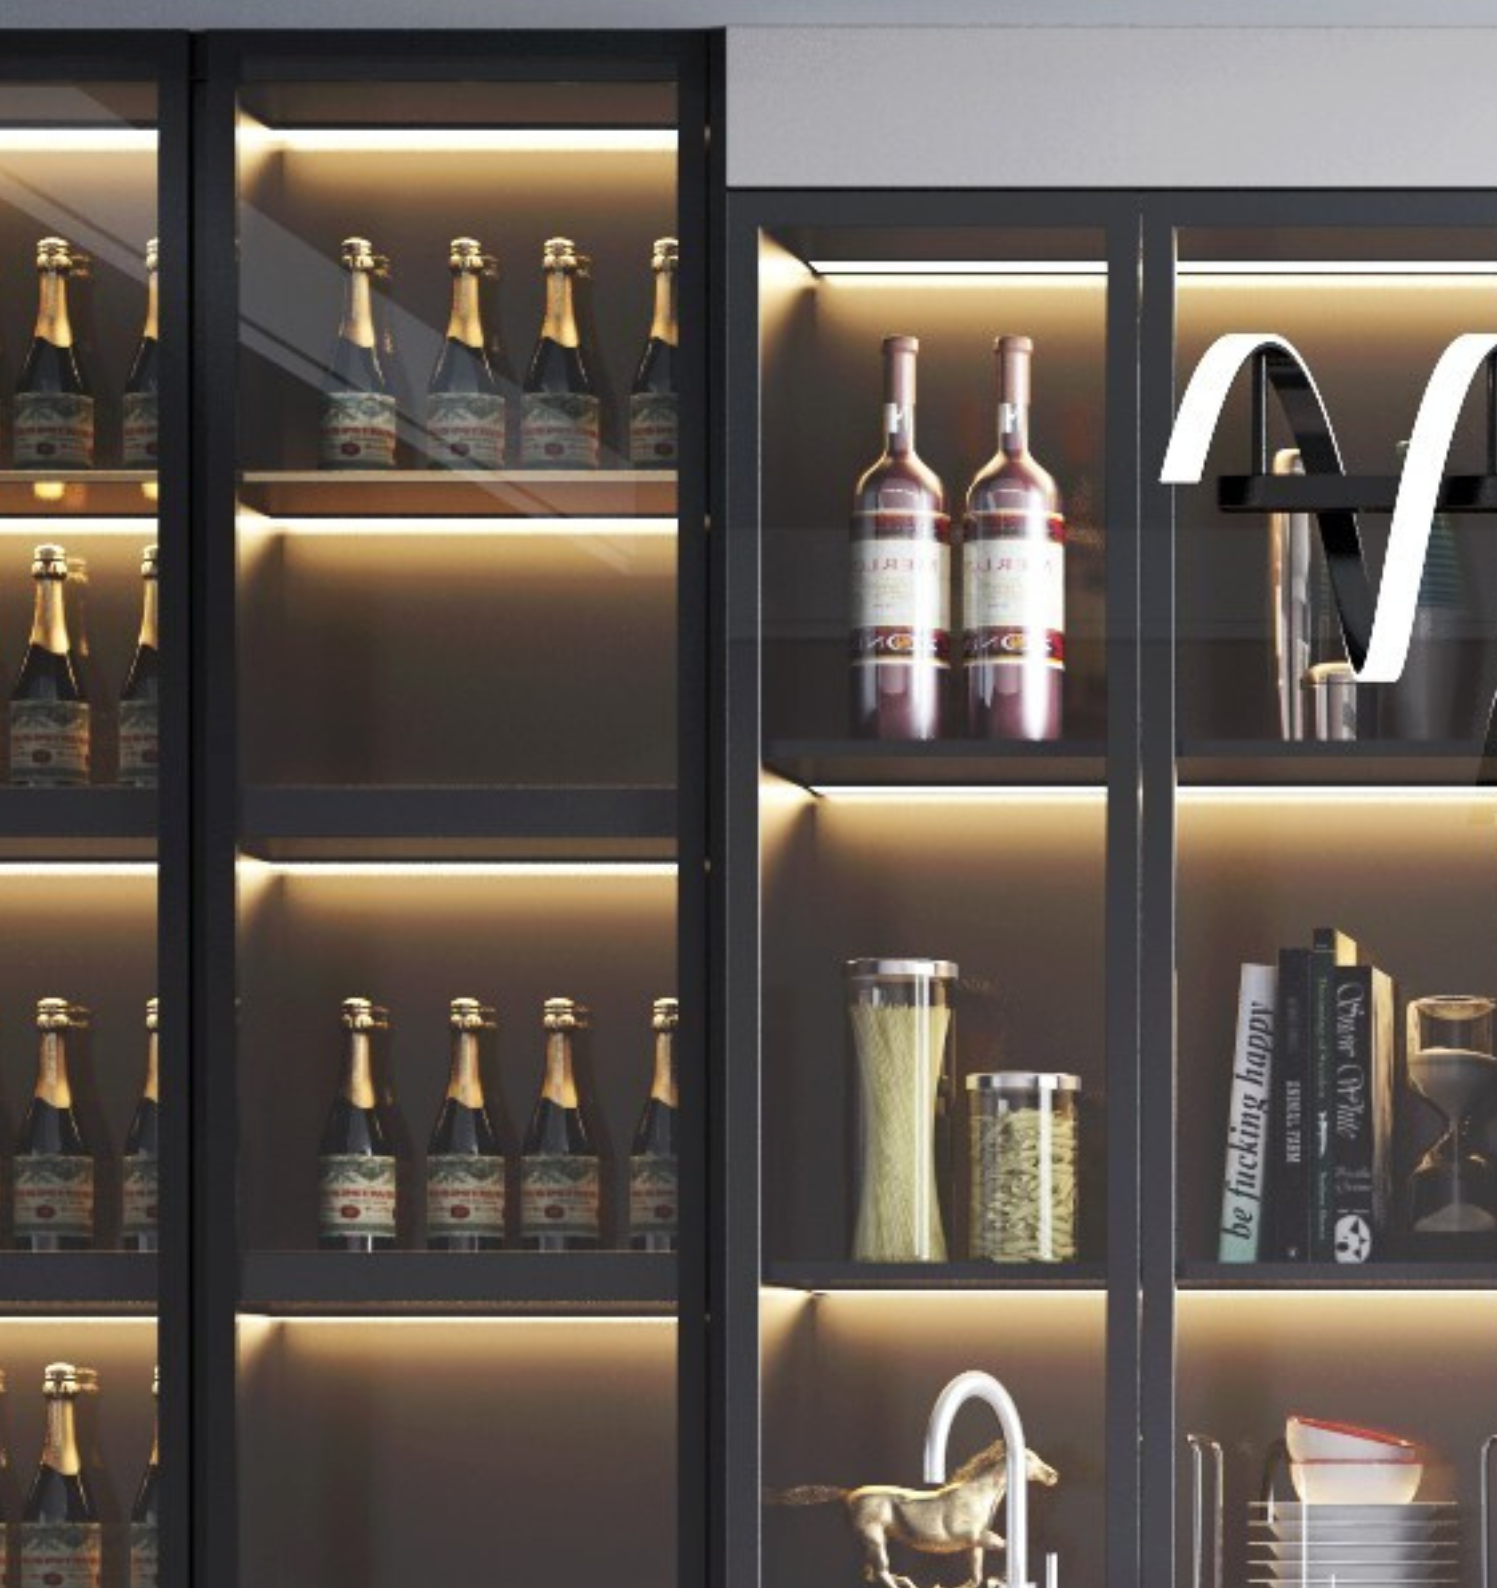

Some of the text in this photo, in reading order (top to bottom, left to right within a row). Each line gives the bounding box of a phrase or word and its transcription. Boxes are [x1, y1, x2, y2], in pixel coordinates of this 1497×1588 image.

[1337, 983, 1365, 1058] Snow
[1221, 1001, 1274, 1240] be fucking happy
[1286, 1080, 1301, 1163] ANIMAL FARM
[1337, 1064, 1365, 1140] White
